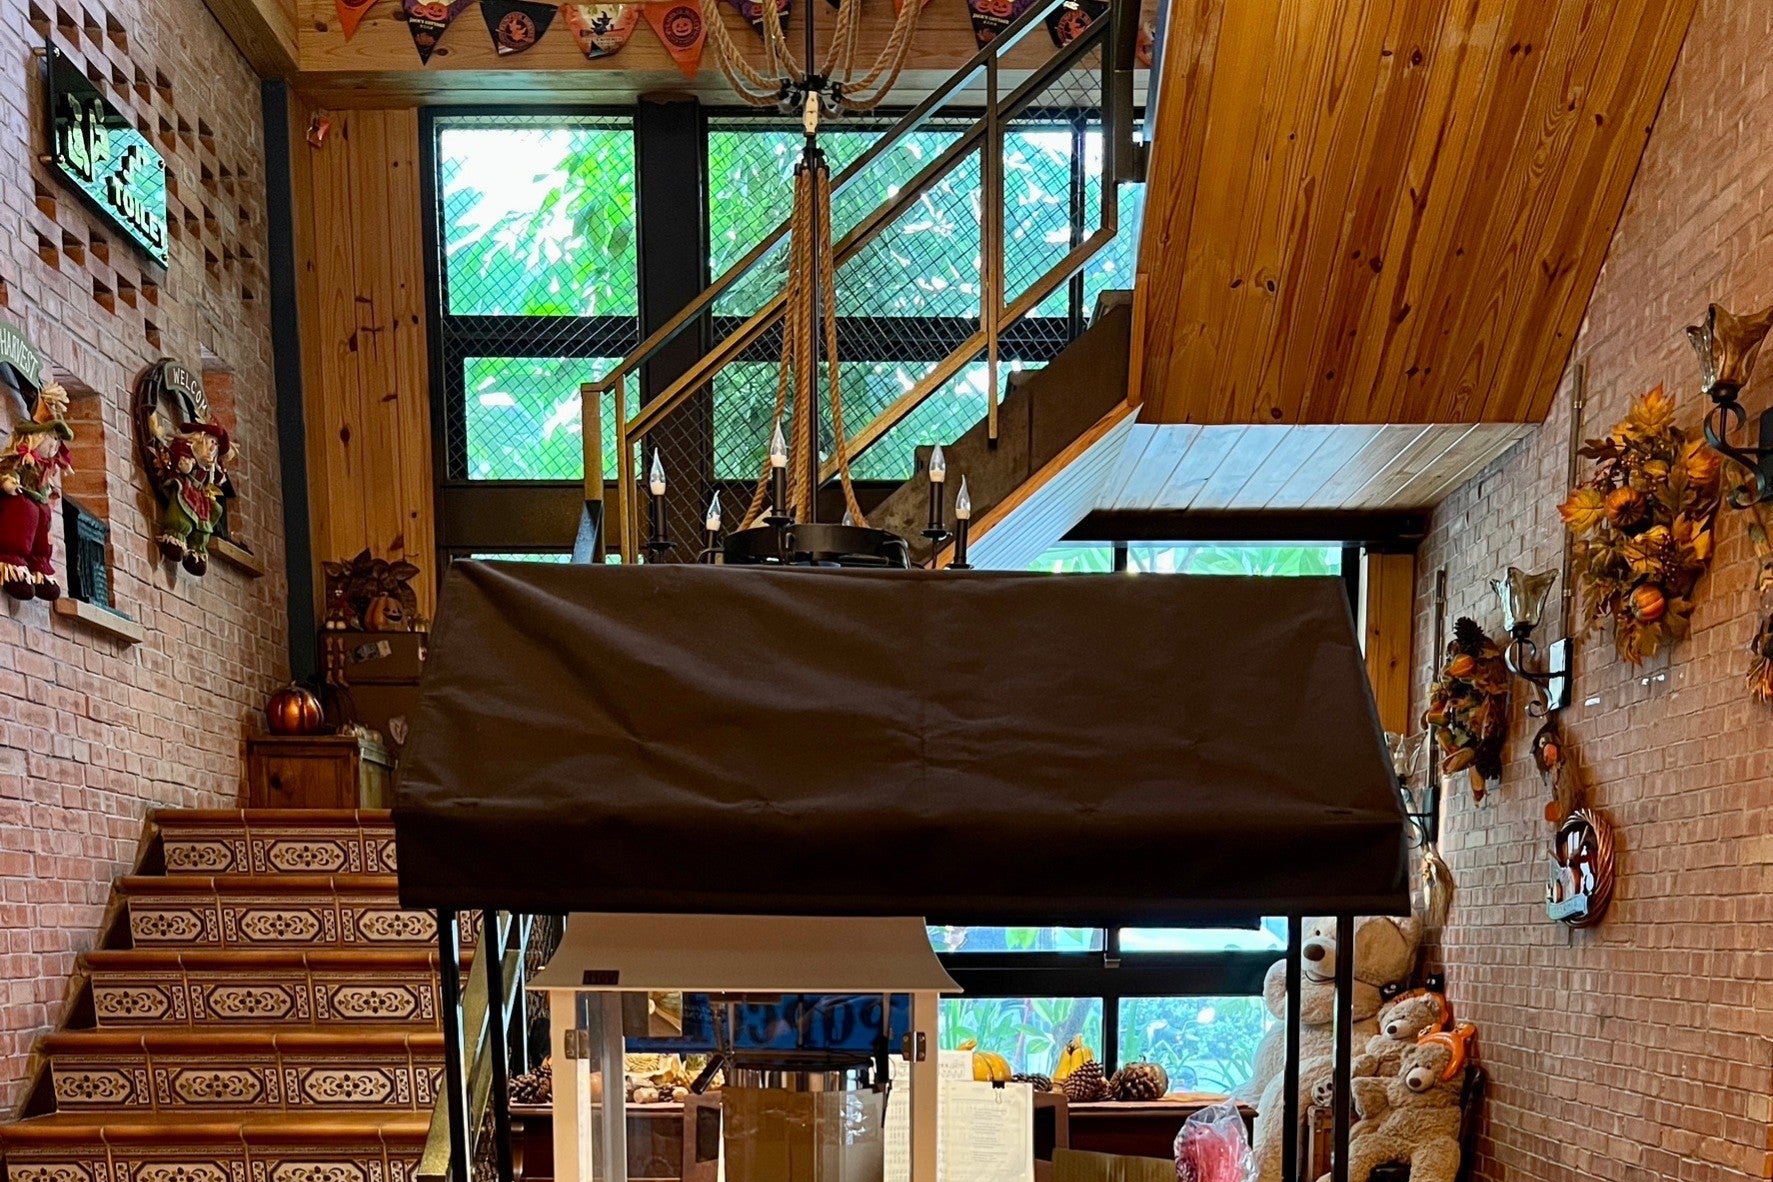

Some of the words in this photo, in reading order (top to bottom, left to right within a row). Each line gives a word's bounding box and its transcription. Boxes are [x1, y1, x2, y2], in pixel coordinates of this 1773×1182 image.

[113, 174, 168, 248] TOILET
[0, 328, 39, 379] HARVEST
[173, 367, 208, 410] WELCOM
